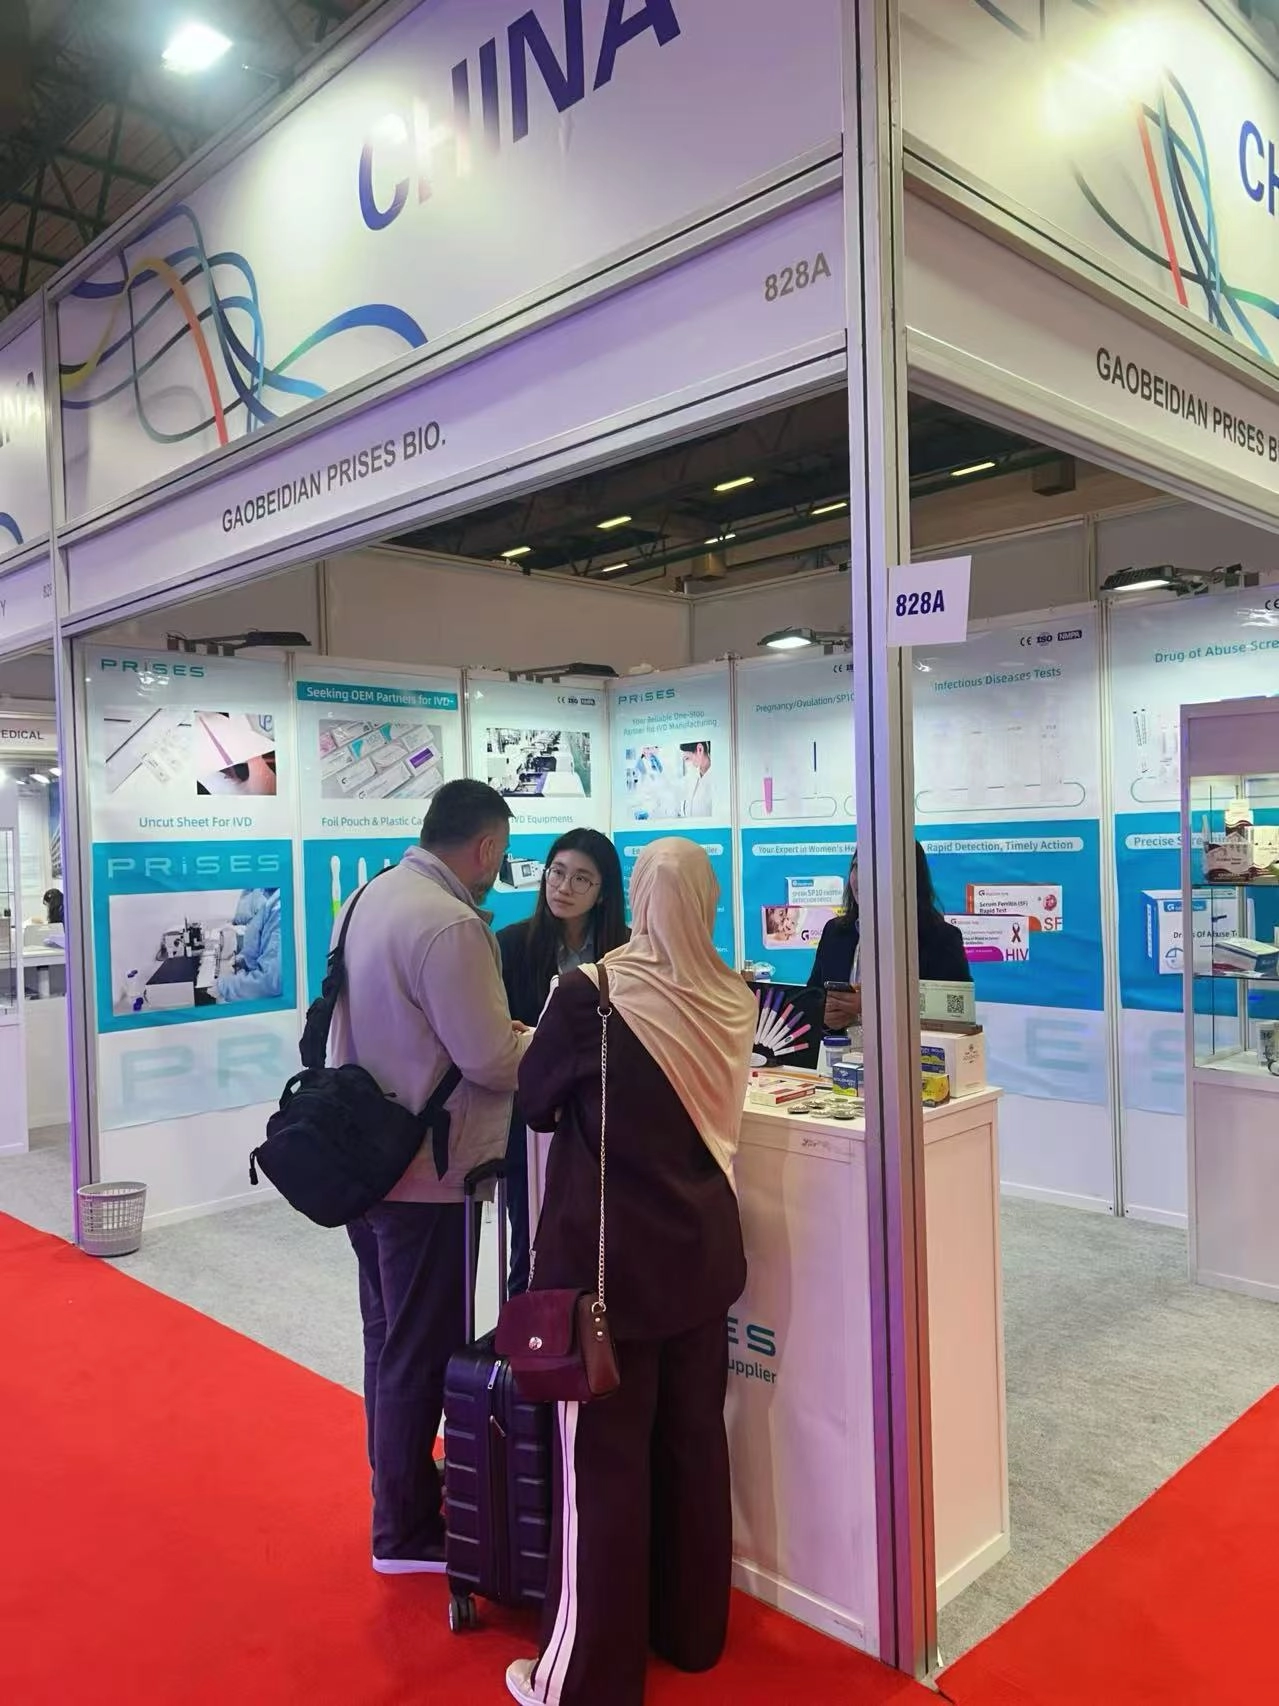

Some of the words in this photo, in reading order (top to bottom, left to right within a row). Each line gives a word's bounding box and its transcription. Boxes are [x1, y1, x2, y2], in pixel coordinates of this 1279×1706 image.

[764, 252, 832, 302] 828A
[1096, 347, 1208, 430] GAOBEIDIAN
[1213, 406, 1265, 457] PRISES
[1268, 435, 1279, 463] B
[222, 470, 321, 533] GAOBEIDIAN
[327, 439, 396, 491] PRISES
[403, 421, 446, 461] BIO.
[896, 589, 945, 617] 828A
[1155, 650, 1185, 664] Drug
[1189, 647, 1202, 659] of
[1205, 644, 1246, 657] Abuse
[934, 678, 983, 692] Infectious
[985, 671, 1031, 685] Diseases
[1034, 666, 1061, 679] Tests
[307, 686, 349, 701] Seeking
[351, 690, 374, 701] OEM
[377, 693, 417, 705] Partners
[419, 694, 431, 705] for
[139, 817, 174, 828] Uncut
[177, 816, 209, 828] Sheet
[212, 816, 229, 828] For
[232, 816, 252, 827] IVD
[321, 816, 339, 827] Foil
[341, 816, 371, 827] Pouch
[372, 817, 379, 827] &
[380, 816, 410, 826] Plastic
[411, 816, 424, 826] Ca
[527, 815, 573, 825] Equipments
[927, 843, 953, 853] Rapid
[954, 842, 1003, 852] Detection,
[1005, 841, 1039, 853] Timely
[1040, 840, 1074, 850] Action
[1134, 837, 1175, 847] Precise
[758, 846, 774, 855] Your
[775, 845, 799, 855] Expert
[809, 844, 843, 854] Women's
[1044, 917, 1063, 930] SF
[1197, 930, 1206, 938] Of
[1006, 948, 1028, 961] HIV
